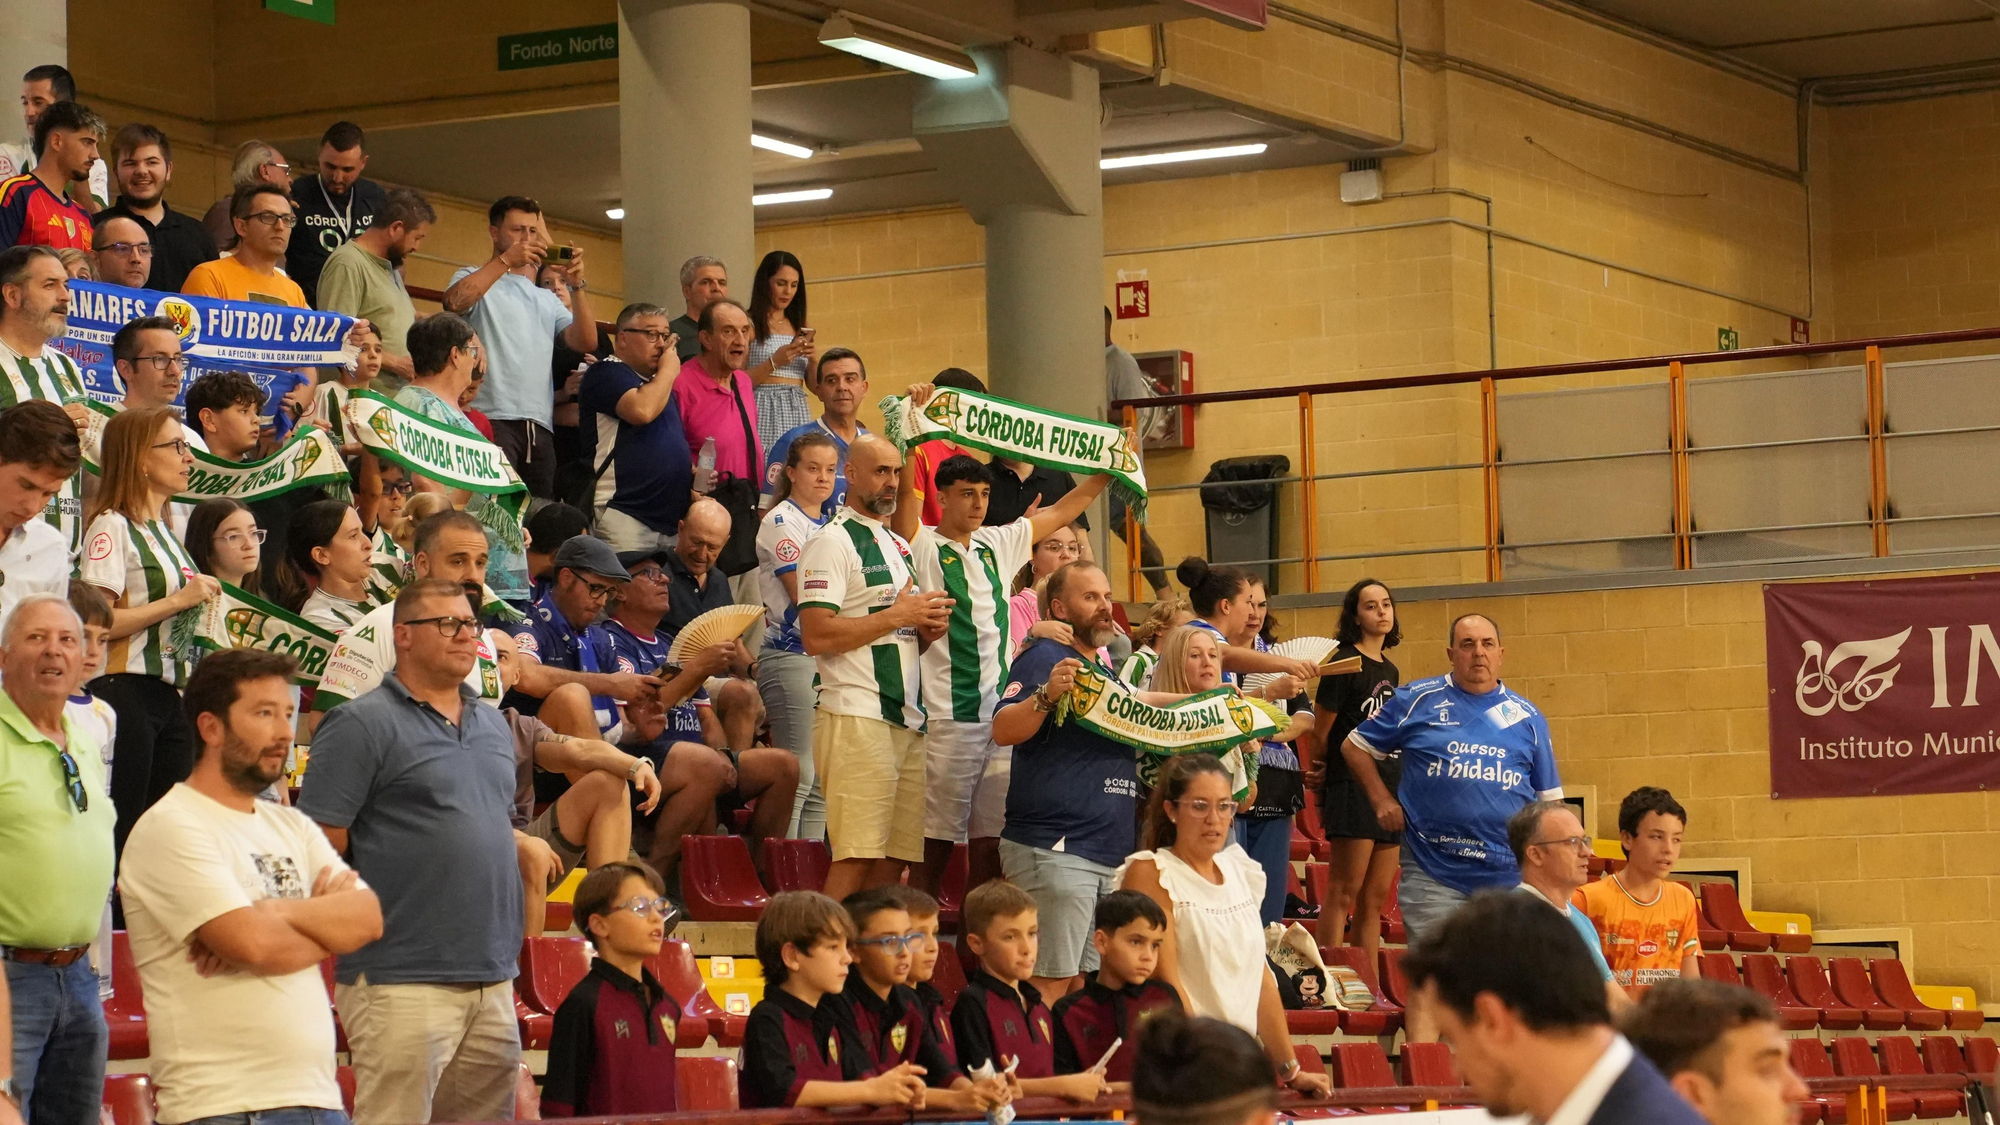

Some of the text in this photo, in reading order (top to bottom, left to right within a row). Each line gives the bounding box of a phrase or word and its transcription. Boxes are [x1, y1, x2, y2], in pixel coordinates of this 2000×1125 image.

[510, 35, 615, 60] Fondo Norte
[67, 289, 147, 326] ANARES
[208, 304, 284, 341] FÚTBOL
[290, 314, 341, 343] SALA
[68, 329, 85, 338] POR
[87, 332, 98, 341] UN
[48, 339, 104, 367] idalgo
[217, 349, 323, 362] LA AFICIÓN: UNA GRAN FAMILIA
[966, 403, 1044, 451] CÓRDOBA
[1050, 425, 1105, 463] FUTSAL
[399, 420, 500, 479] CÓRDOBA FUTSAL
[188, 466, 241, 495] DOBA
[233, 453, 292, 494] FUTSAL
[267, 632, 330, 677] CÓR
[336, 661, 368, 680] IMDECO
[675, 711, 701, 732] hida
[1102, 714, 1135, 733] CÓRDOBA
[1107, 692, 1175, 732] CÓRDOBA
[1177, 704, 1225, 732] FUTSAL
[1447, 741, 1506, 759] Quesos
[1800, 736, 1913, 760] Instituto
[1427, 756, 1522, 791] el hidalgo
